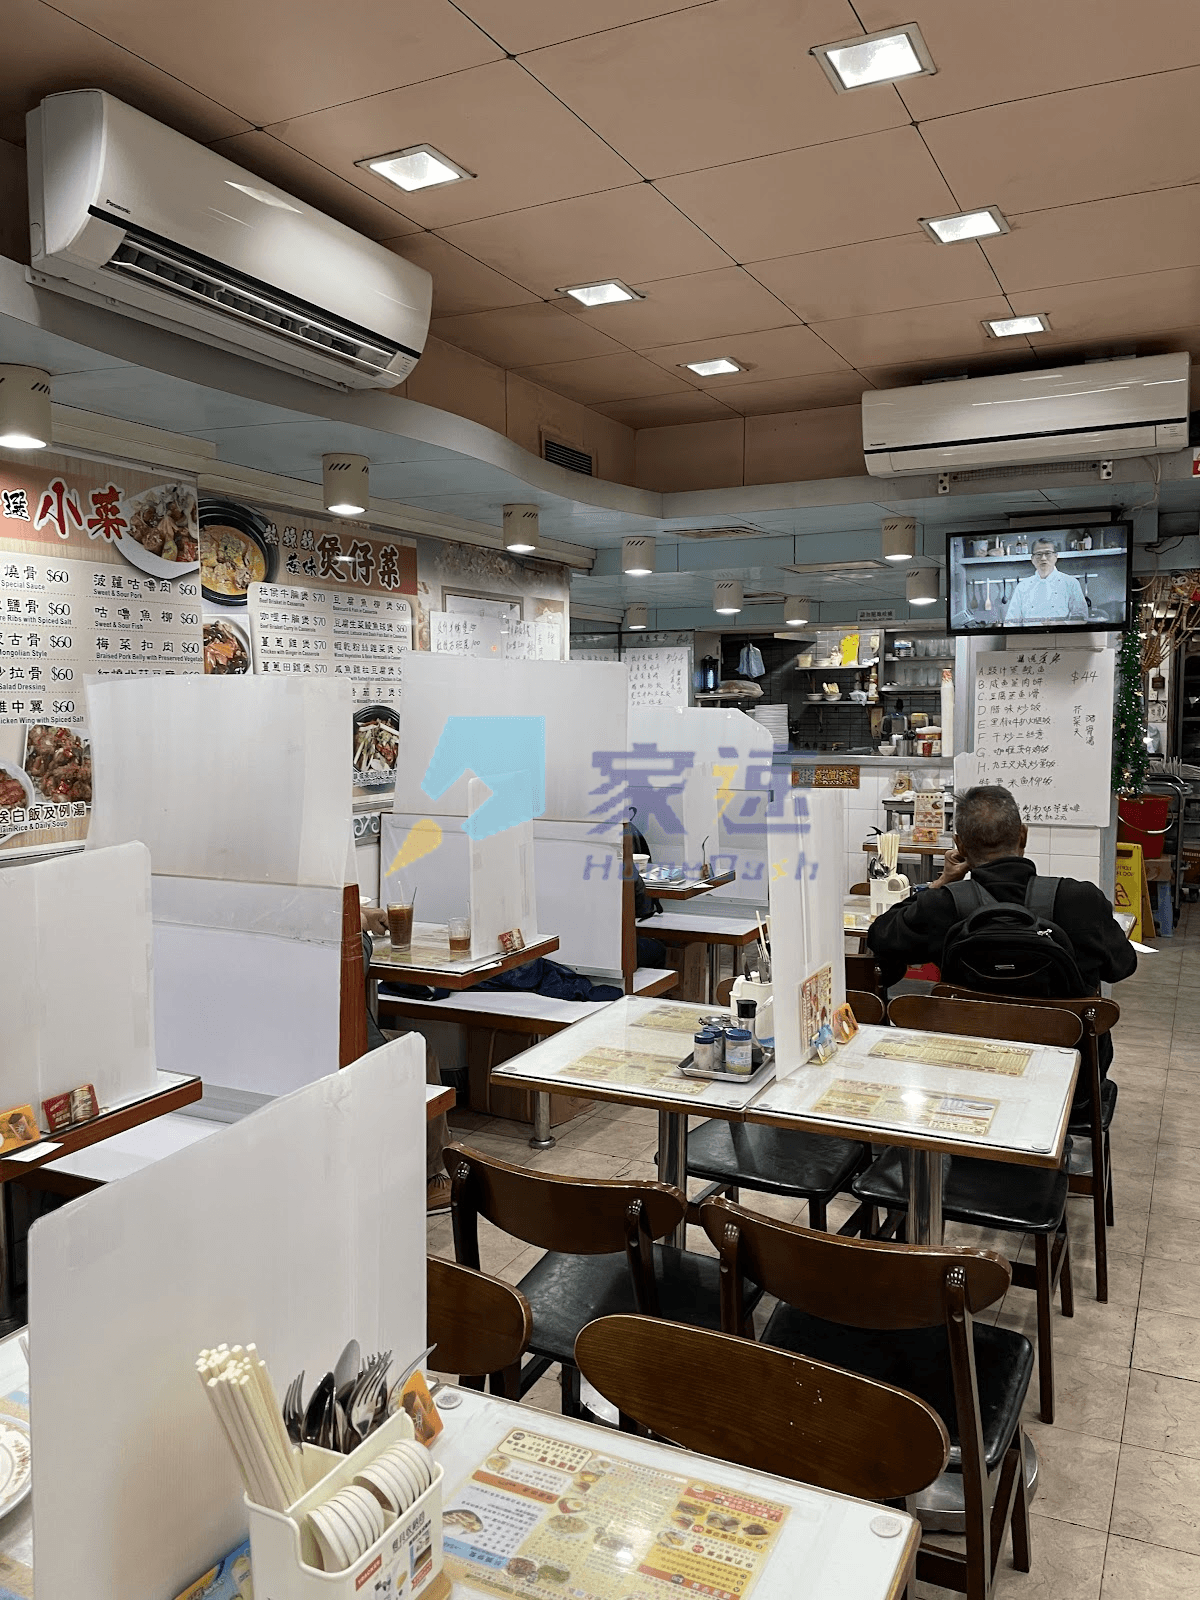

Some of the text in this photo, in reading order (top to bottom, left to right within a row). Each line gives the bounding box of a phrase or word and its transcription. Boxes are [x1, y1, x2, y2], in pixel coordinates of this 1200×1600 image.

[2, 478, 129, 543] 選 小菜
[316, 533, 400, 591] 煲仔菜
[4, 564, 69, 583] 燒骨 $60
[1, 579, 46, 590] Special Sauce
[93, 574, 197, 596] 菠蘿咕嚕肉 $60
[94, 588, 110, 596] Sweet
[312, 592, 326, 603] $70
[0, 598, 71, 616] 鹽骨 $60
[396, 602, 406, 611] $60
[7, 614, 22, 622] Ribs
[38, 616, 58, 625] Spiced
[95, 606, 198, 625] 咕嚕魚柳 $60
[313, 616, 326, 626] $70
[396, 624, 408, 633] $60
[50, 635, 72, 649] $60
[96, 637, 199, 654] 梅菜扣肉 $60
[313, 640, 327, 650] $70
[32, 649, 47, 658] Style
[51, 666, 74, 681] $60
[314, 663, 328, 674] $70
[1071, 670, 1098, 684] $44
[18, 683, 46, 692] Dressing
[52, 700, 75, 714] $60
[19, 716, 35, 724] Wing
[51, 716, 72, 724] Spiced
[73, 715, 84, 723] Salt
[14, 824, 28, 832] Rice
[35, 822, 51, 830] Daily
[52, 820, 68, 828] Soup
